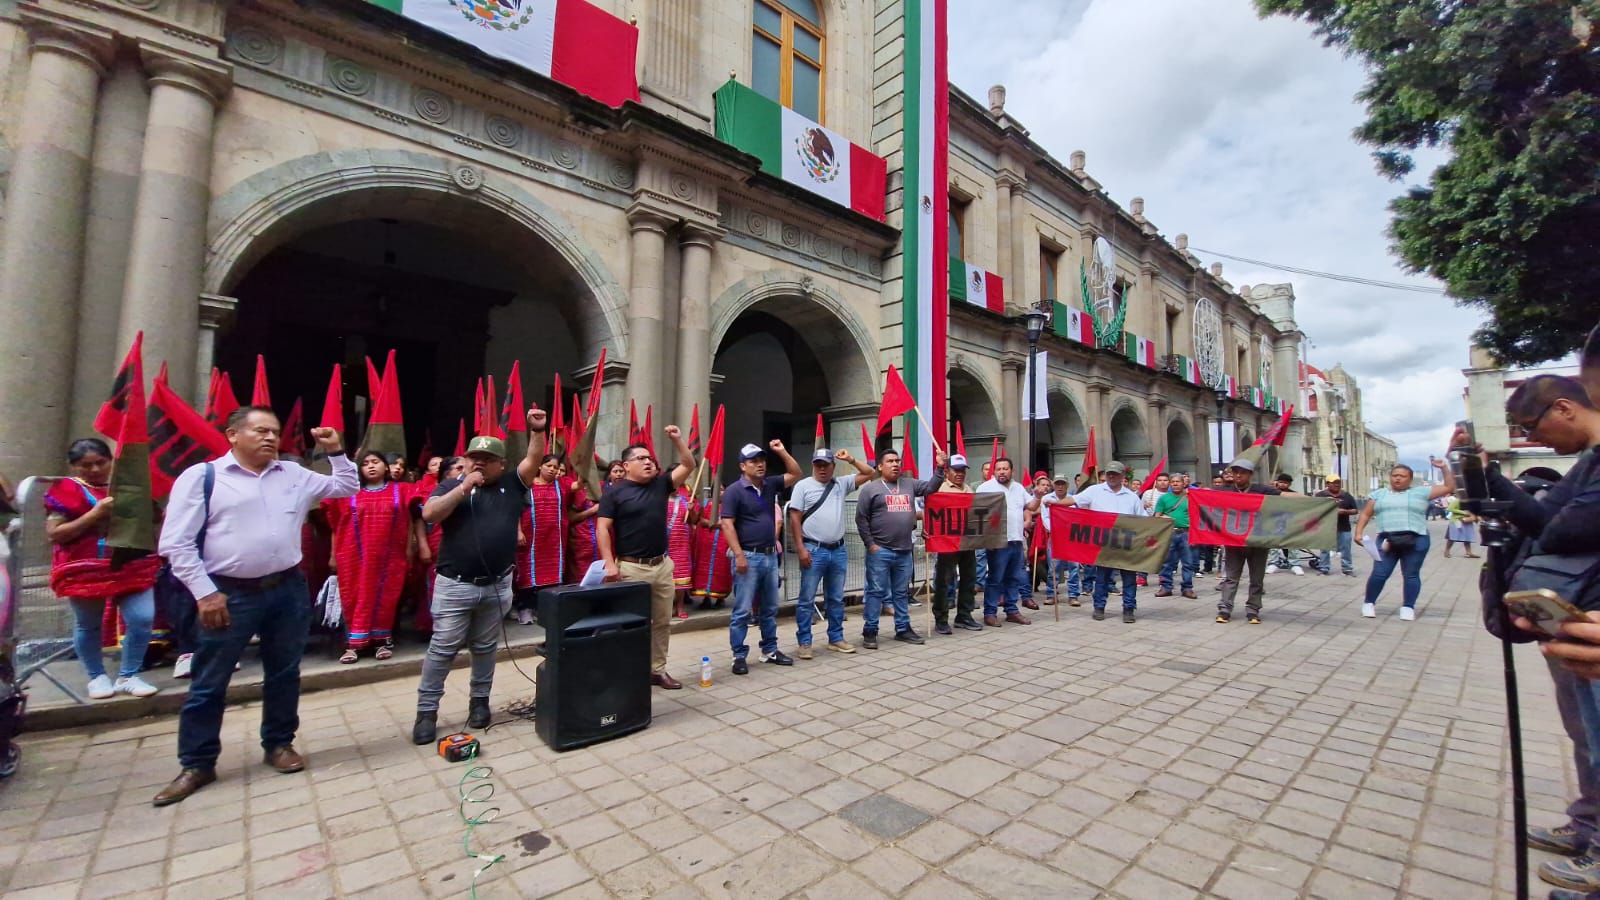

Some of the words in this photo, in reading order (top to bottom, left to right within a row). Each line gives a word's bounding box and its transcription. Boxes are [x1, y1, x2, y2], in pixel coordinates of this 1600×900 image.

[928, 507, 989, 535] MULT
[1199, 504, 1294, 537] MULT
[1069, 523, 1137, 551] MULT
